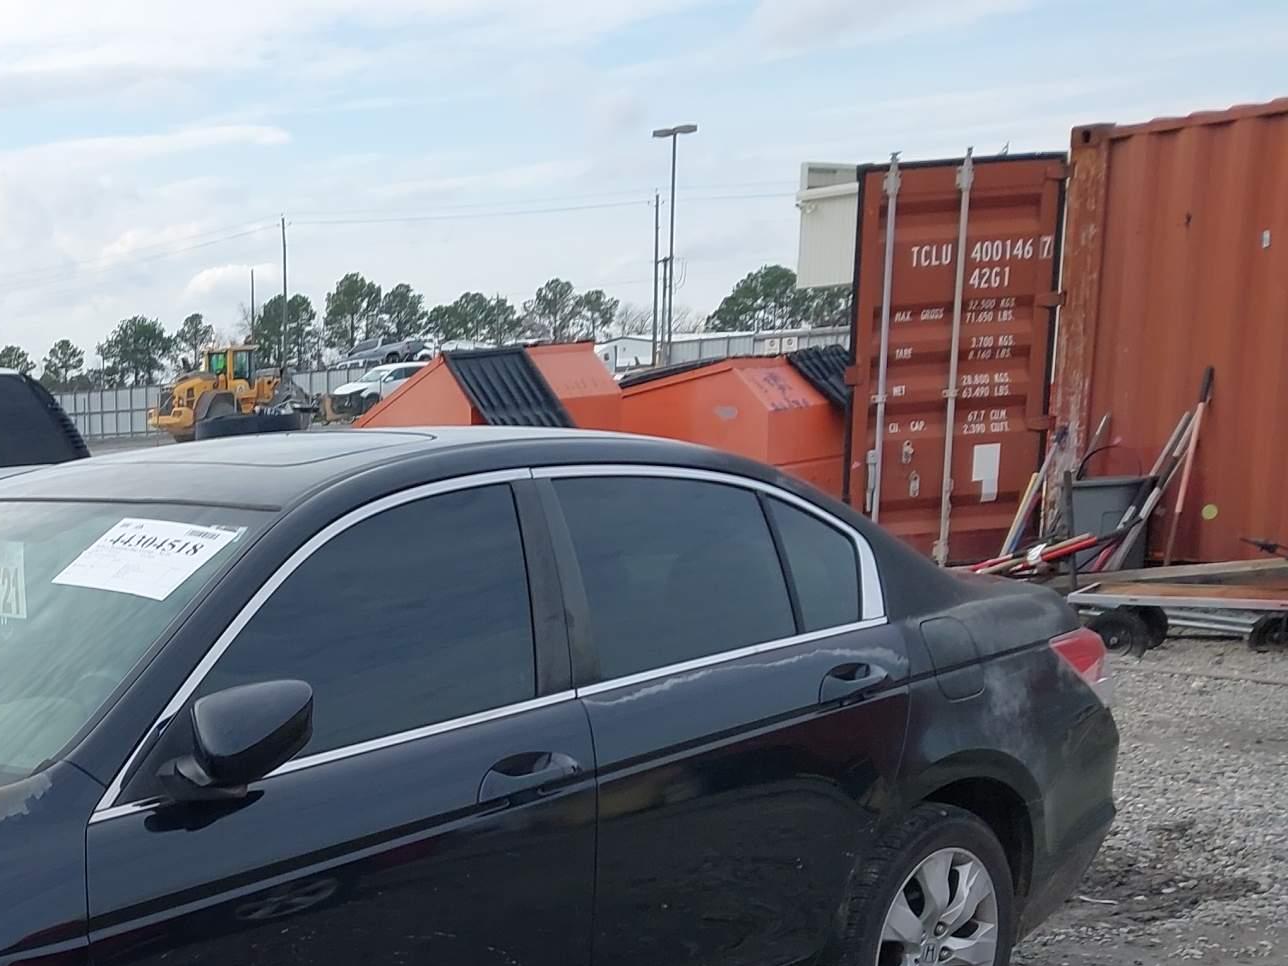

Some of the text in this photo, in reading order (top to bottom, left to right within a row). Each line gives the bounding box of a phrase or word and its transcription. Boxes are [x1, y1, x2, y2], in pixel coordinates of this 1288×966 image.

[911, 236, 1052, 267] TCLU 400146 7
[969, 266, 1010, 288] 42G1
[920, 307, 944, 320] GROSS
[892, 385, 906, 397] NET
[910, 420, 926, 432] CAP.
[111, 532, 204, 556] 44304518
